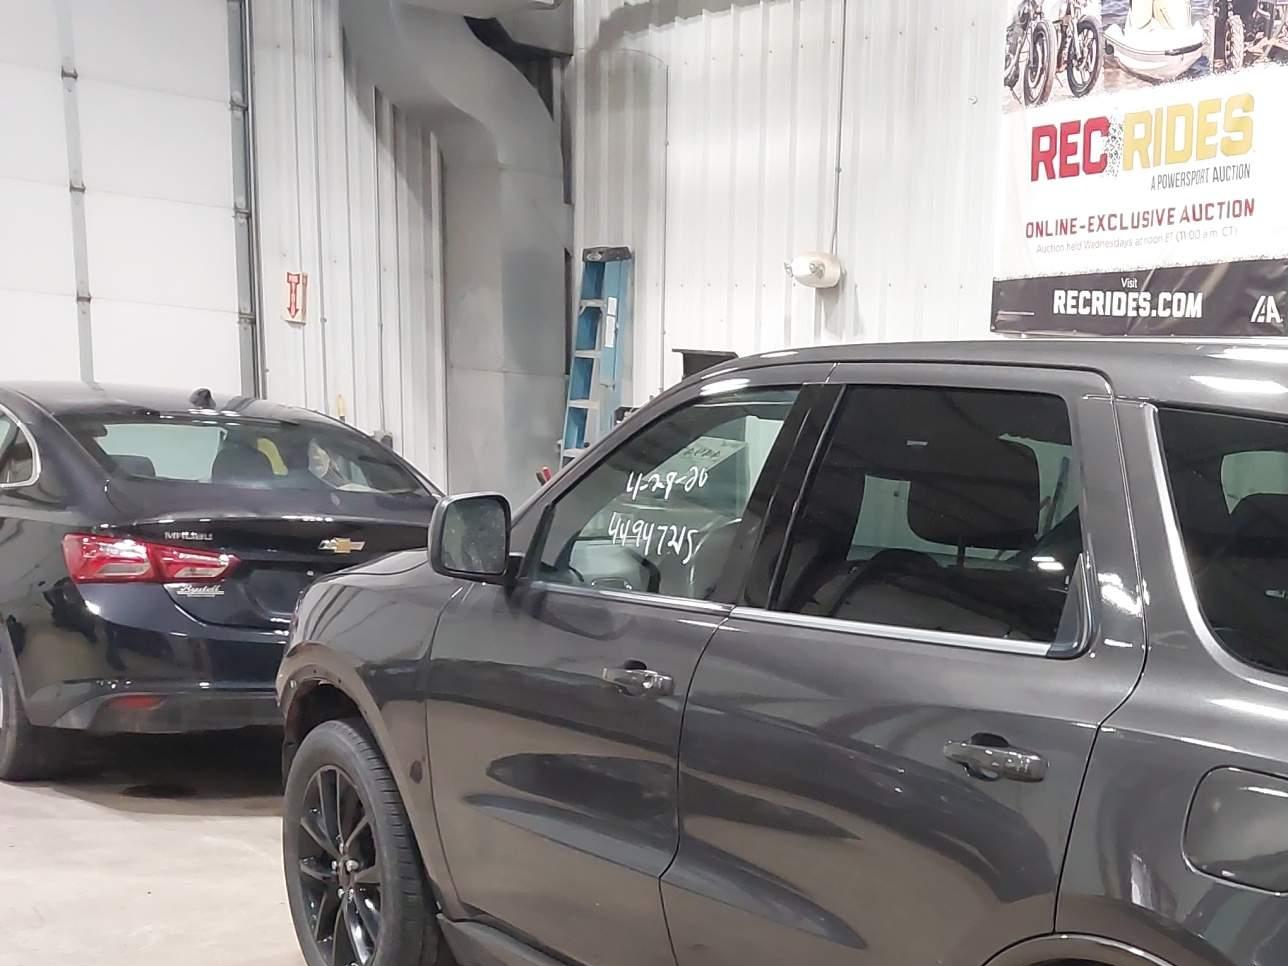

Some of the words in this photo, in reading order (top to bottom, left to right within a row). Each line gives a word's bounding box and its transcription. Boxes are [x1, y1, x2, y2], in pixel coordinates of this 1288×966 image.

[1030, 116, 1111, 182] REC
[1122, 93, 1255, 171] RIDES
[1150, 176, 1156, 191] A
[1157, 167, 1210, 191] POWERSPORT
[1212, 163, 1251, 184] AUCTION
[1026, 207, 1176, 239] ONLINE-EXCLUSIVE
[1179, 198, 1255, 224] AUCTION
[1036, 242, 1065, 254] Auction
[1084, 237, 1133, 250] Wednesdays
[1120, 277, 1138, 288] Visit
[1053, 289, 1203, 318] RECRIDES.COM
